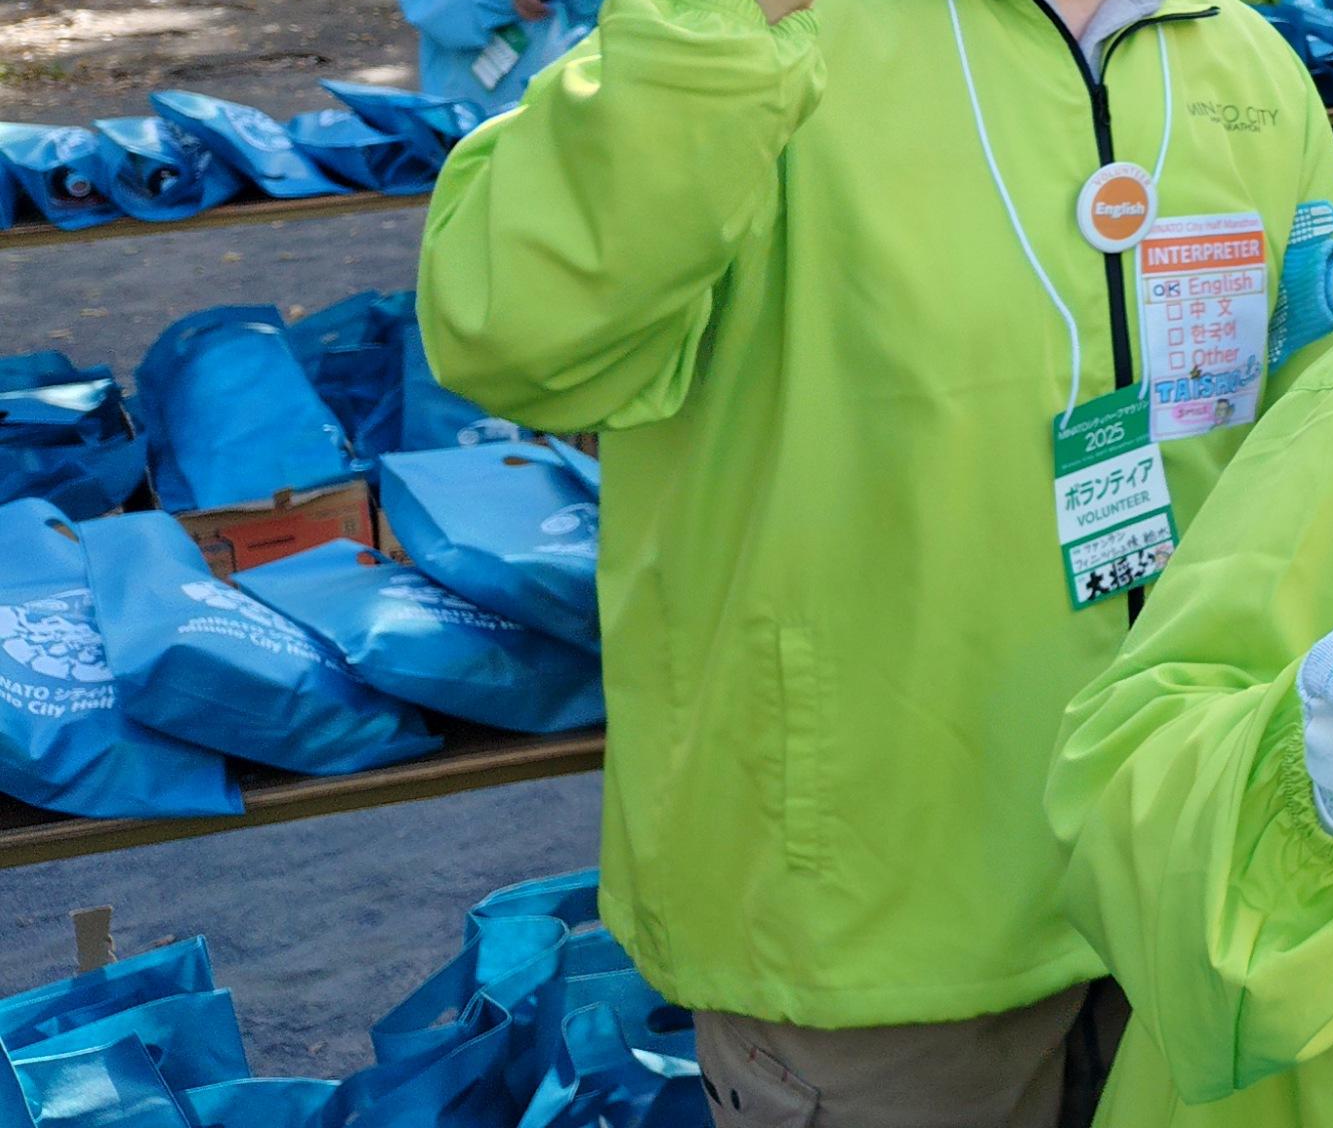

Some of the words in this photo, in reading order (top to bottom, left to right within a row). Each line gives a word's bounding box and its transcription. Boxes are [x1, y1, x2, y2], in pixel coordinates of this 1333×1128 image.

[1245, 106, 1280, 127] CITY
[1095, 201, 1146, 219] English
[1147, 239, 1261, 267] INTERPRETER
[1188, 273, 1253, 297] English
[1191, 319, 1237, 344] 한국어
[1192, 346, 1239, 369] Other
[1085, 421, 1125, 452] 2025
[1064, 457, 1154, 511] ボランティア
[1076, 490, 1151, 527] VOLUNTEER
[27, 700, 66, 719] City
